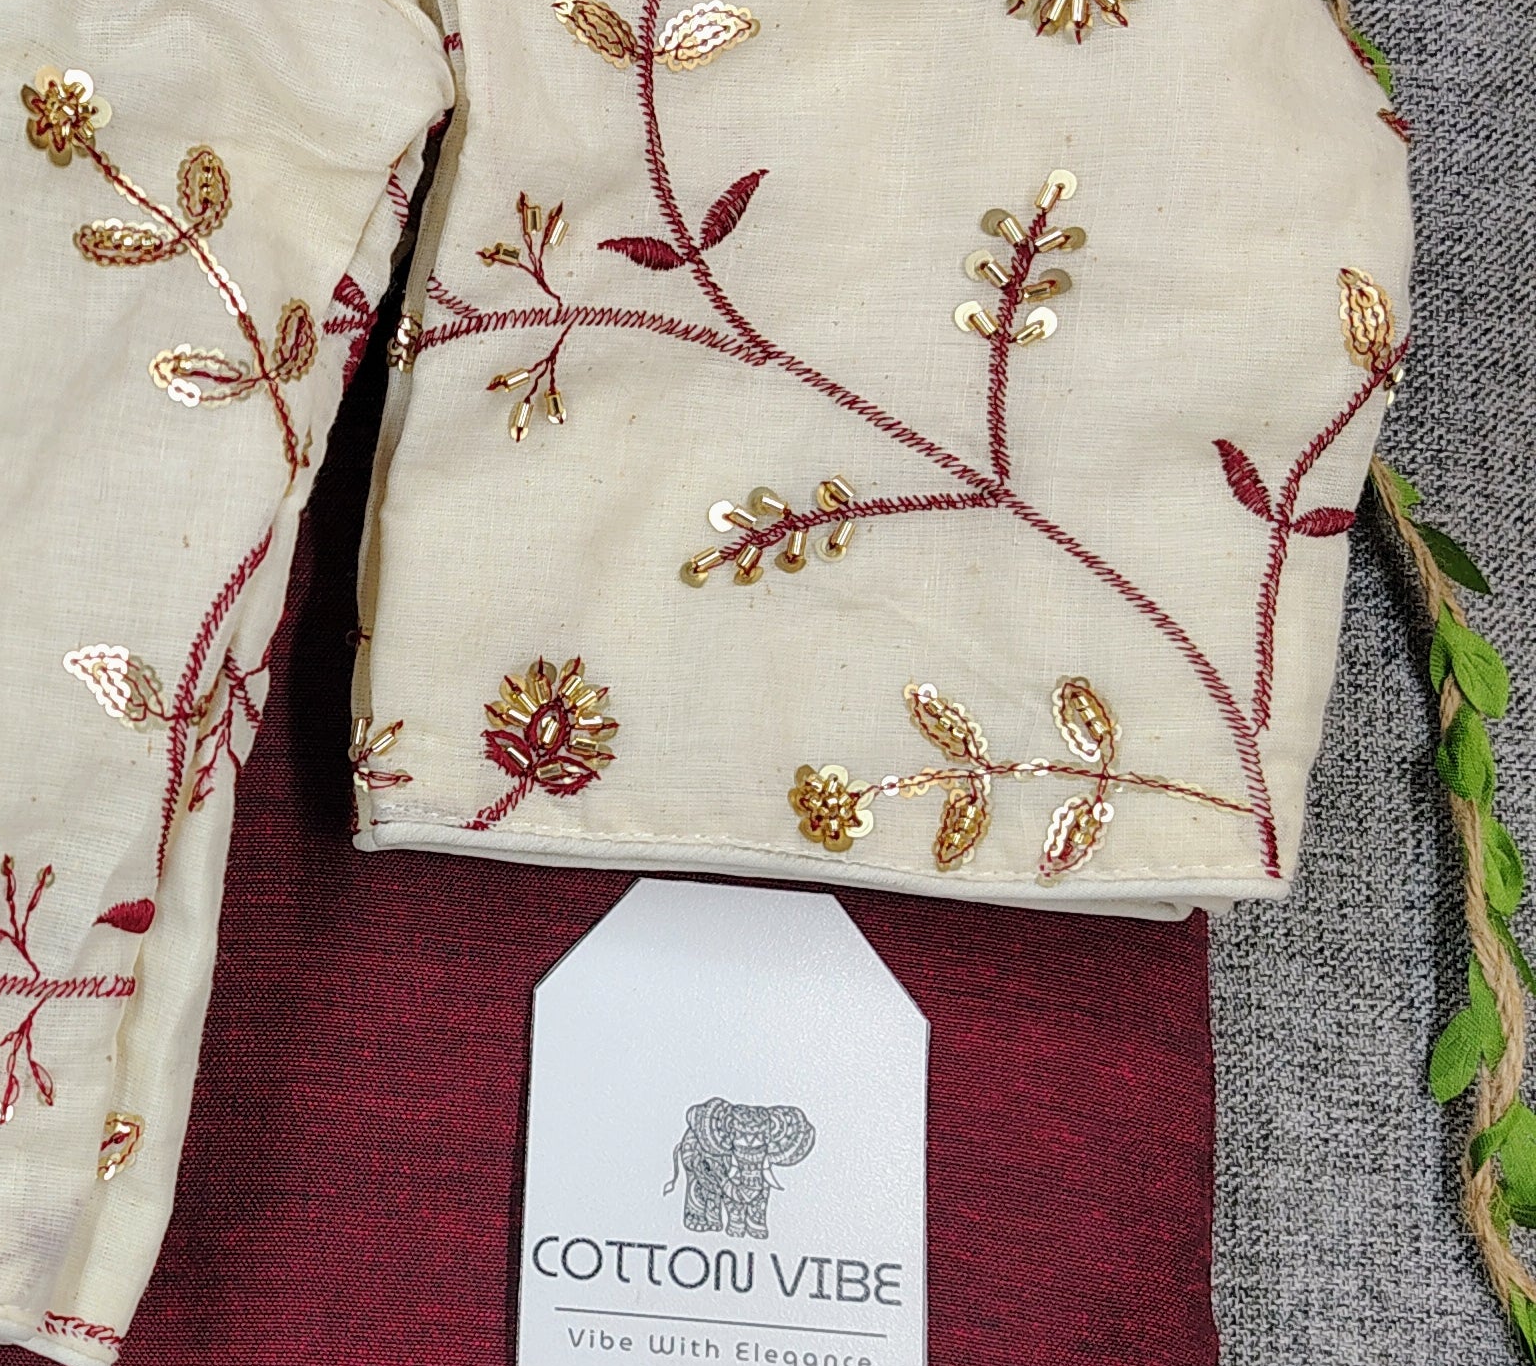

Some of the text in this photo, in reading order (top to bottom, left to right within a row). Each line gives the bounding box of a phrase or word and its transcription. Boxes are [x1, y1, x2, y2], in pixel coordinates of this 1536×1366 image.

[531, 1235, 903, 1307] COTTON VIBE
[567, 1327, 633, 1352] Vibe
[649, 1334, 720, 1359] With
